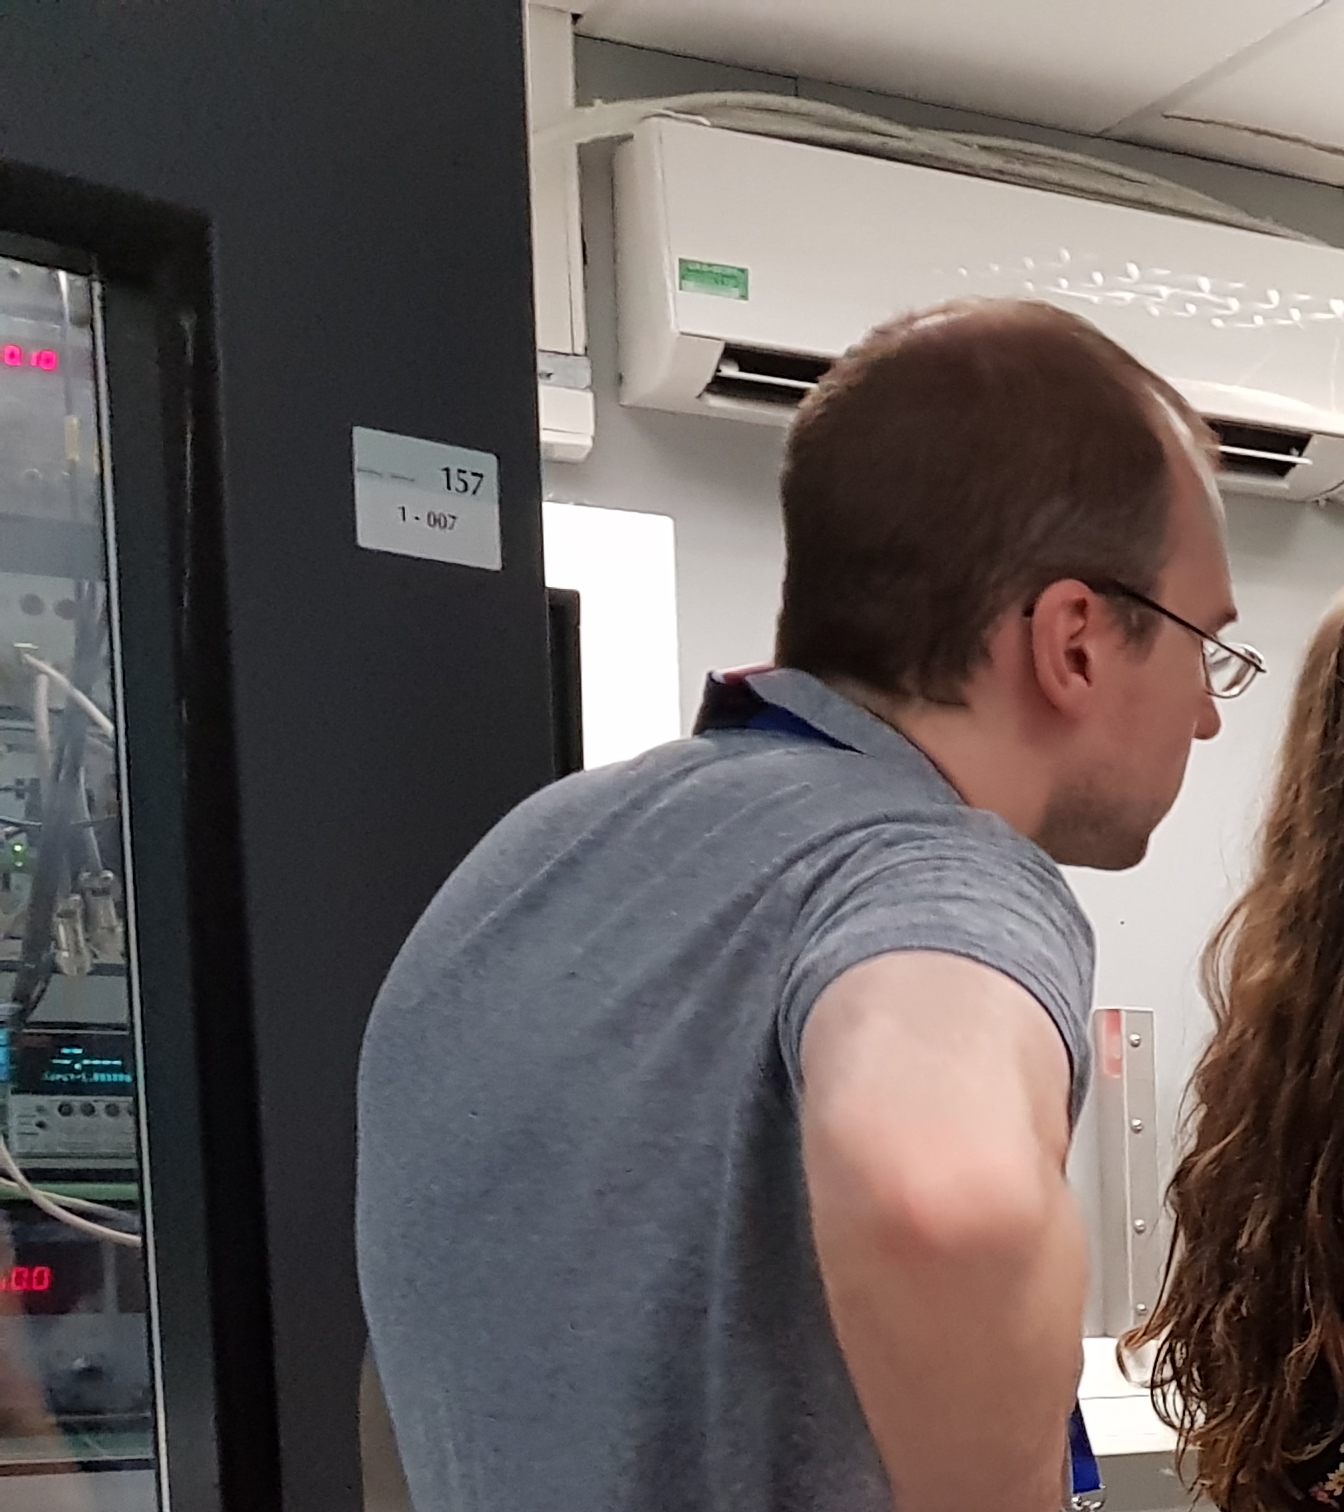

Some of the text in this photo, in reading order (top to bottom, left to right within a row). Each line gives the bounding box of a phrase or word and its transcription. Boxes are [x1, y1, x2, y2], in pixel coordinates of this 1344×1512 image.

[440, 466, 485, 496] 157
[398, 505, 407, 523] 1
[426, 510, 459, 531] 007
